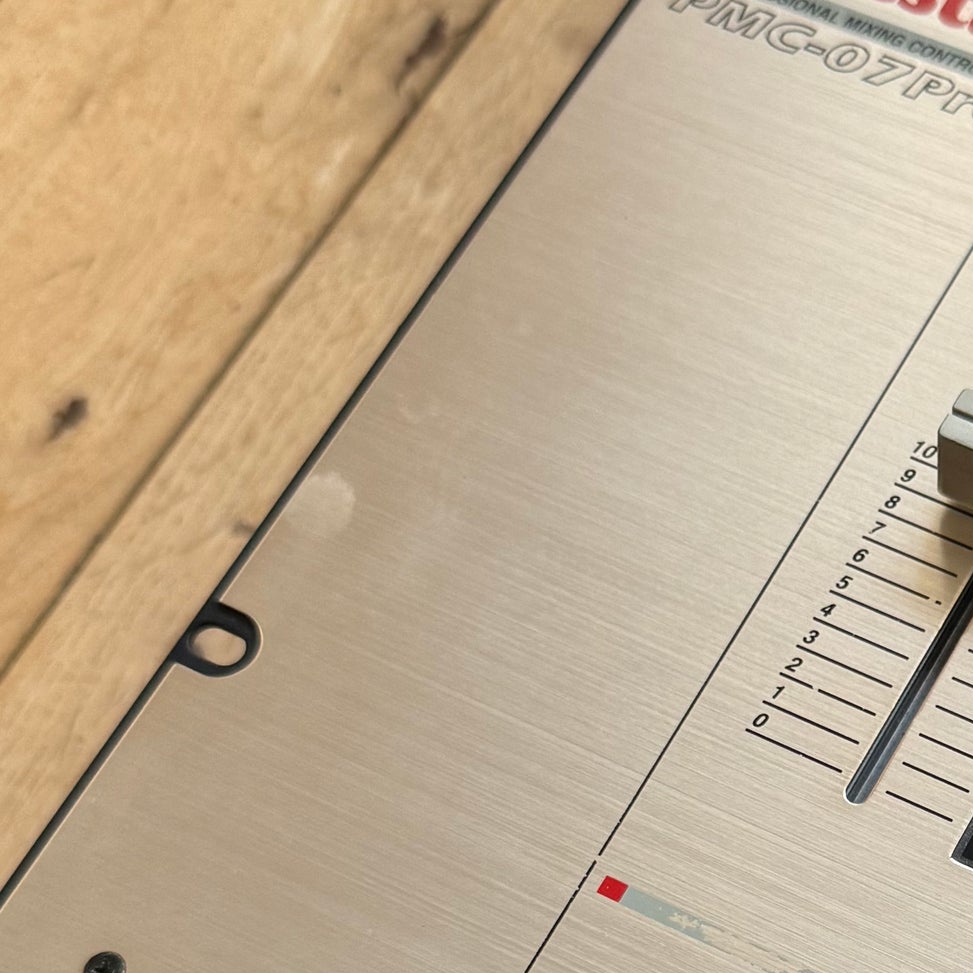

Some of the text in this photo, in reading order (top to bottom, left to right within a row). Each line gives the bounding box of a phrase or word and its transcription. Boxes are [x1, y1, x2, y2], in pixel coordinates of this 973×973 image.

[844, 17, 905, 47] MIXING
[913, 440, 937, 460] 10
[900, 469, 917, 483] 9
[884, 495, 901, 510] 8
[869, 521, 886, 535] 7
[852, 548, 869, 563] 6
[836, 575, 853, 590] 5
[820, 602, 836, 617] 4
[802, 630, 820, 644] 3
[785, 657, 803, 672] 2
[772, 685, 785, 700] 1
[752, 713, 769, 728] 0
